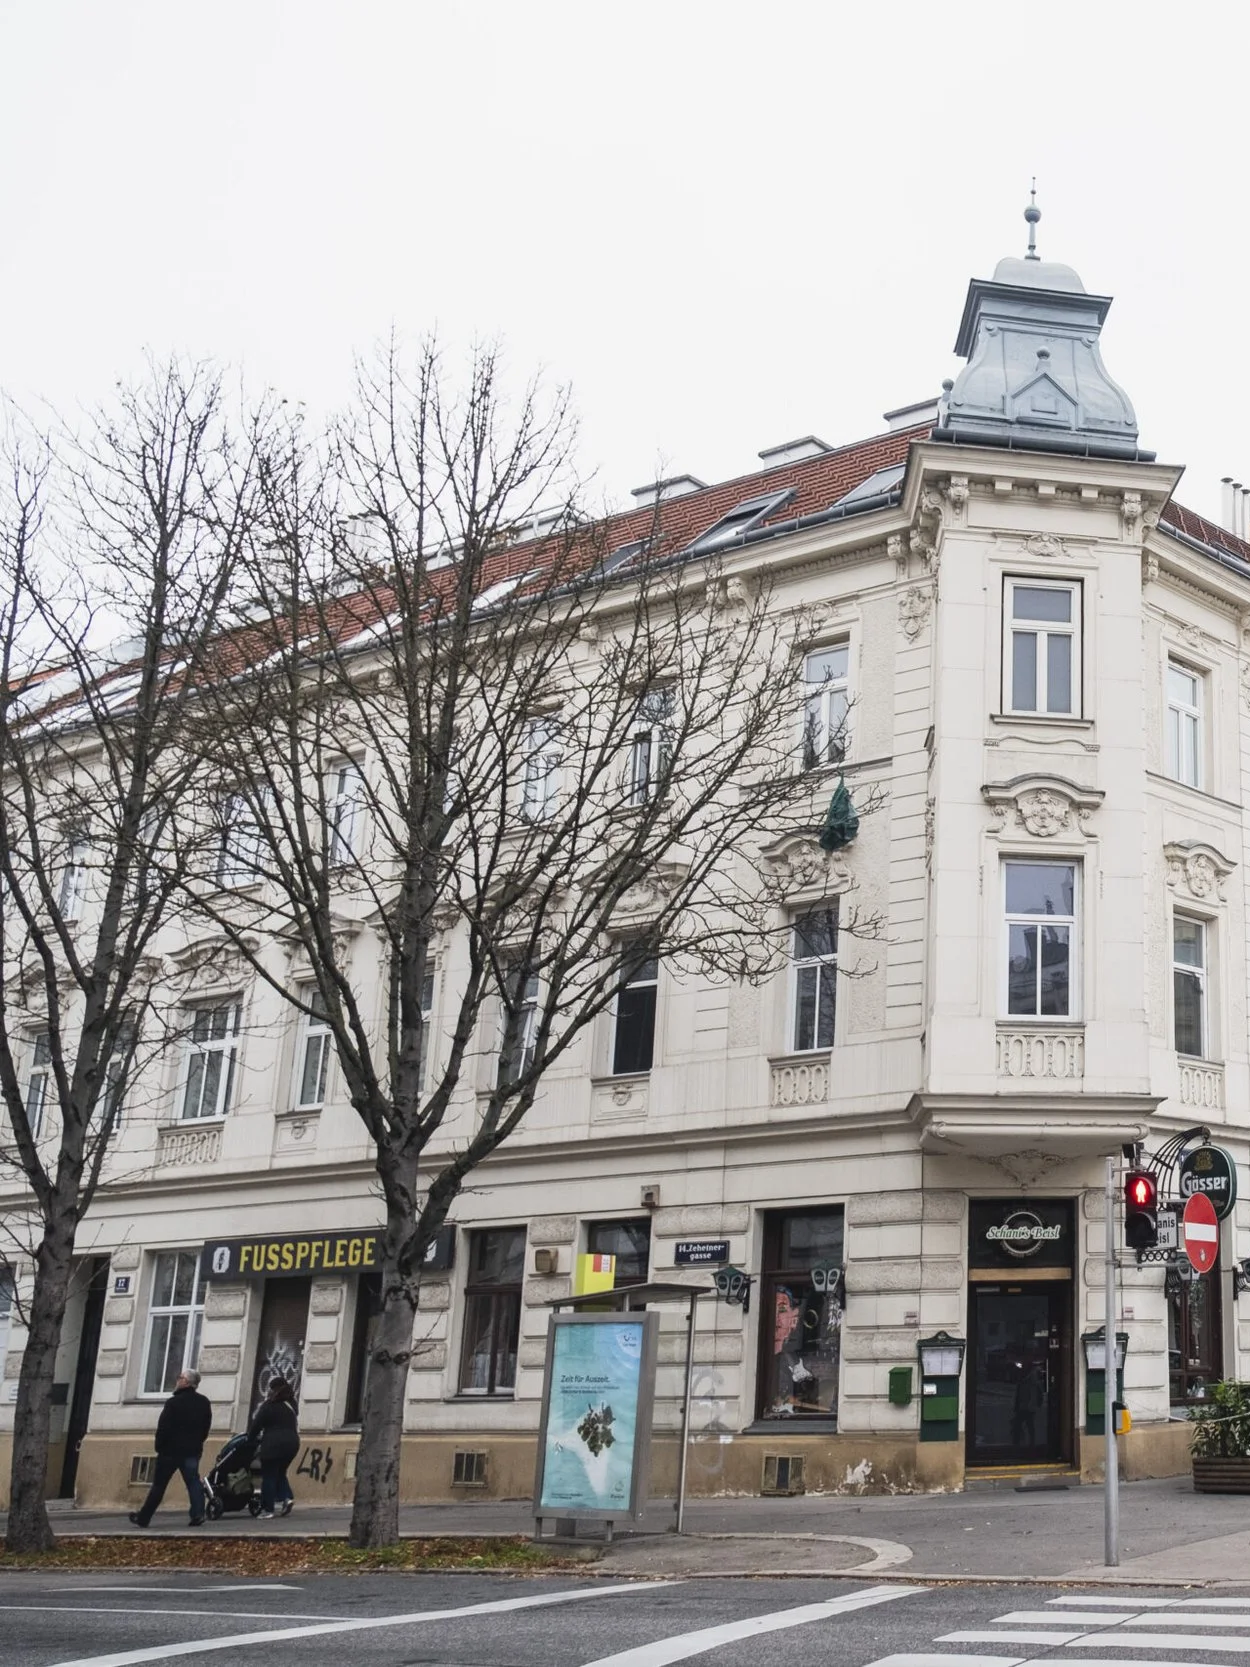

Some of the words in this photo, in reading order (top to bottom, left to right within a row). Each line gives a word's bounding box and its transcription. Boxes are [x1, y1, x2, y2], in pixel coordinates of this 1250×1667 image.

[1181, 1171, 1228, 1196] Gösser
[1157, 1216, 1175, 1229] anis
[985, 1224, 1031, 1240] Schani's
[1030, 1224, 1061, 1240] Beisl
[1159, 1231, 1170, 1244] isl
[239, 1237, 376, 1272] FUSSPFLEGE
[690, 1253, 712, 1261] gasse
[561, 1375, 573, 1383] Zeit
[574, 1375, 584, 1383] für
